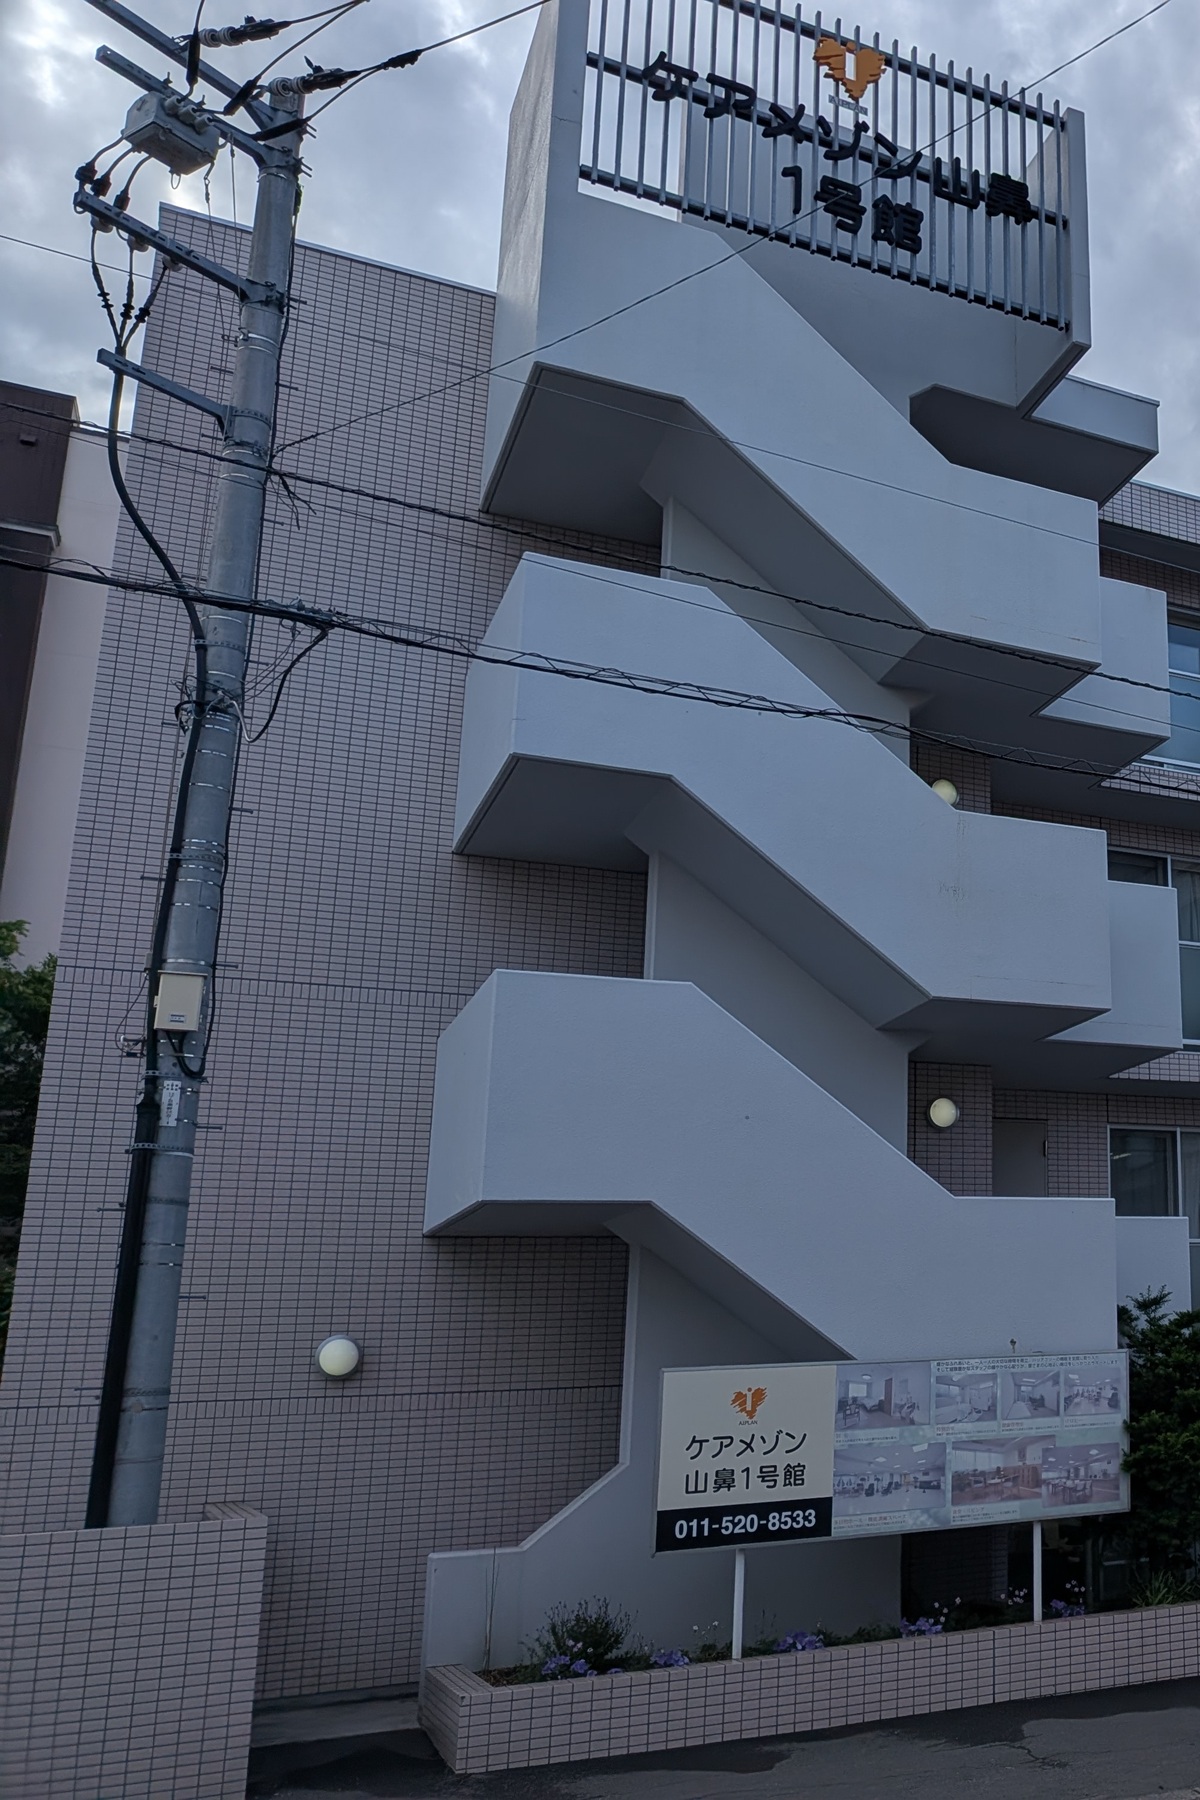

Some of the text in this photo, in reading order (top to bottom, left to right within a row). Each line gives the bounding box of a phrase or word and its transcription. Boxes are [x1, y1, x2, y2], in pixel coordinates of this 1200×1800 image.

[641, 50, 1034, 226] ケアメゾン山鼻
[781, 164, 925, 256] 1号館
[685, 1429, 807, 1460] ケアメゾン
[685, 1463, 807, 1494] 山鼻1号館
[674, 1509, 816, 1539] 011-520-8533
